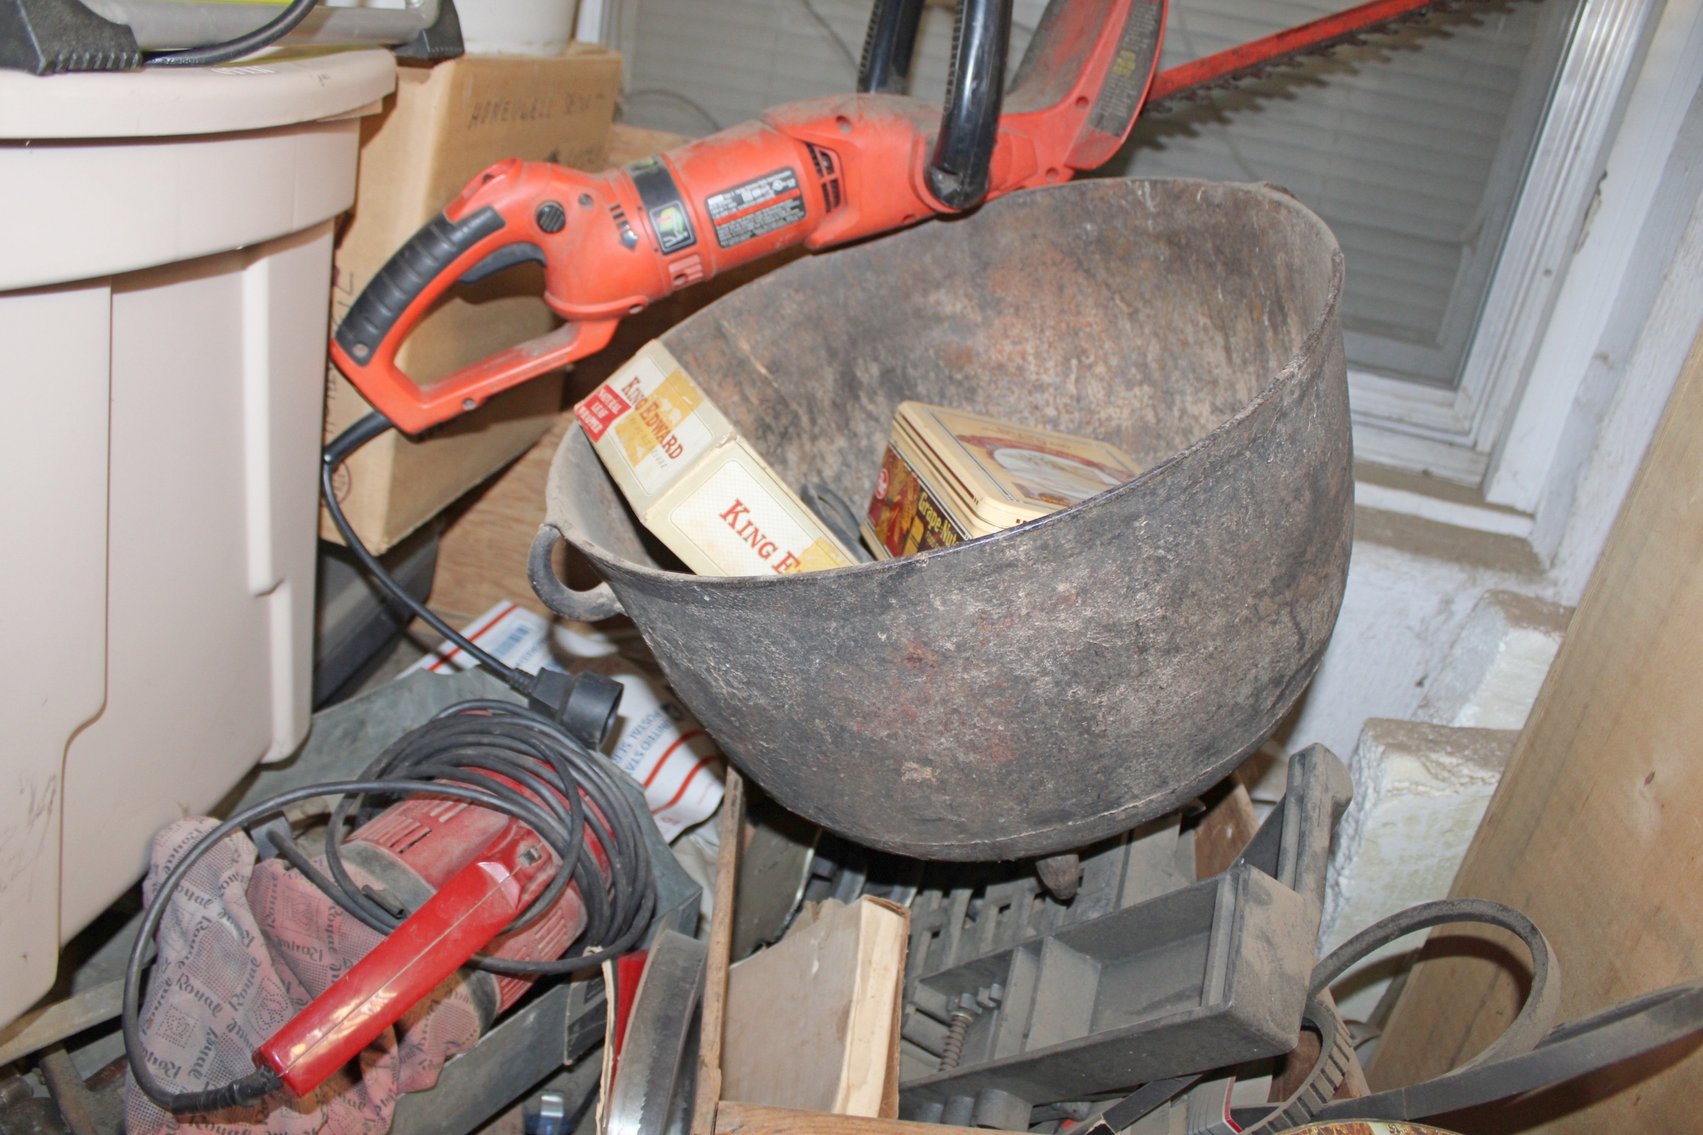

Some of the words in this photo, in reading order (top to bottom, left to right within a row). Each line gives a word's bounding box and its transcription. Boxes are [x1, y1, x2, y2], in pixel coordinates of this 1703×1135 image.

[623, 377, 647, 410] KING
[640, 400, 683, 460] EDWARD
[719, 498, 778, 560] KING
[918, 491, 958, 547] Grape-Nut
[175, 884, 215, 910] oyal
[175, 972, 223, 1018] Royal
[228, 955, 262, 1012] Royal
